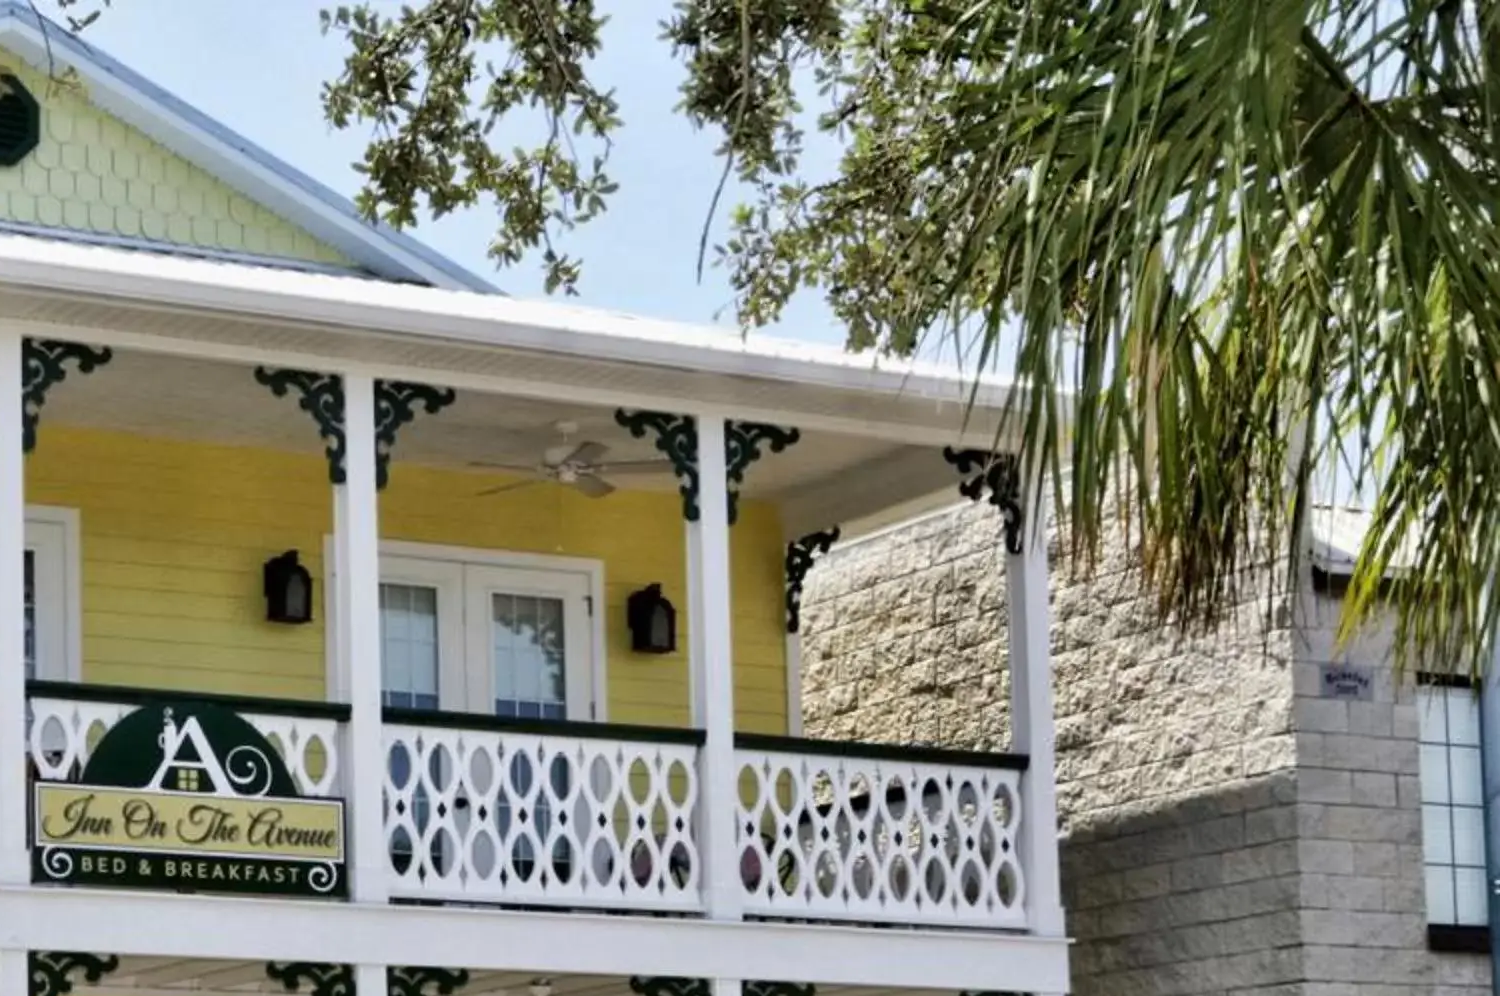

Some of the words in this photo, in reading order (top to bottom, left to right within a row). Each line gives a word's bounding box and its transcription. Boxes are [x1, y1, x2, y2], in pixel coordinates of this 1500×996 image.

[43, 795, 113, 840] Inn
[122, 798, 167, 840] On
[176, 804, 239, 846] The
[246, 807, 338, 848] Avenue
[80, 855, 127, 875] BED
[138, 858, 152, 877] &
[164, 860, 302, 884] BREAKFAST
